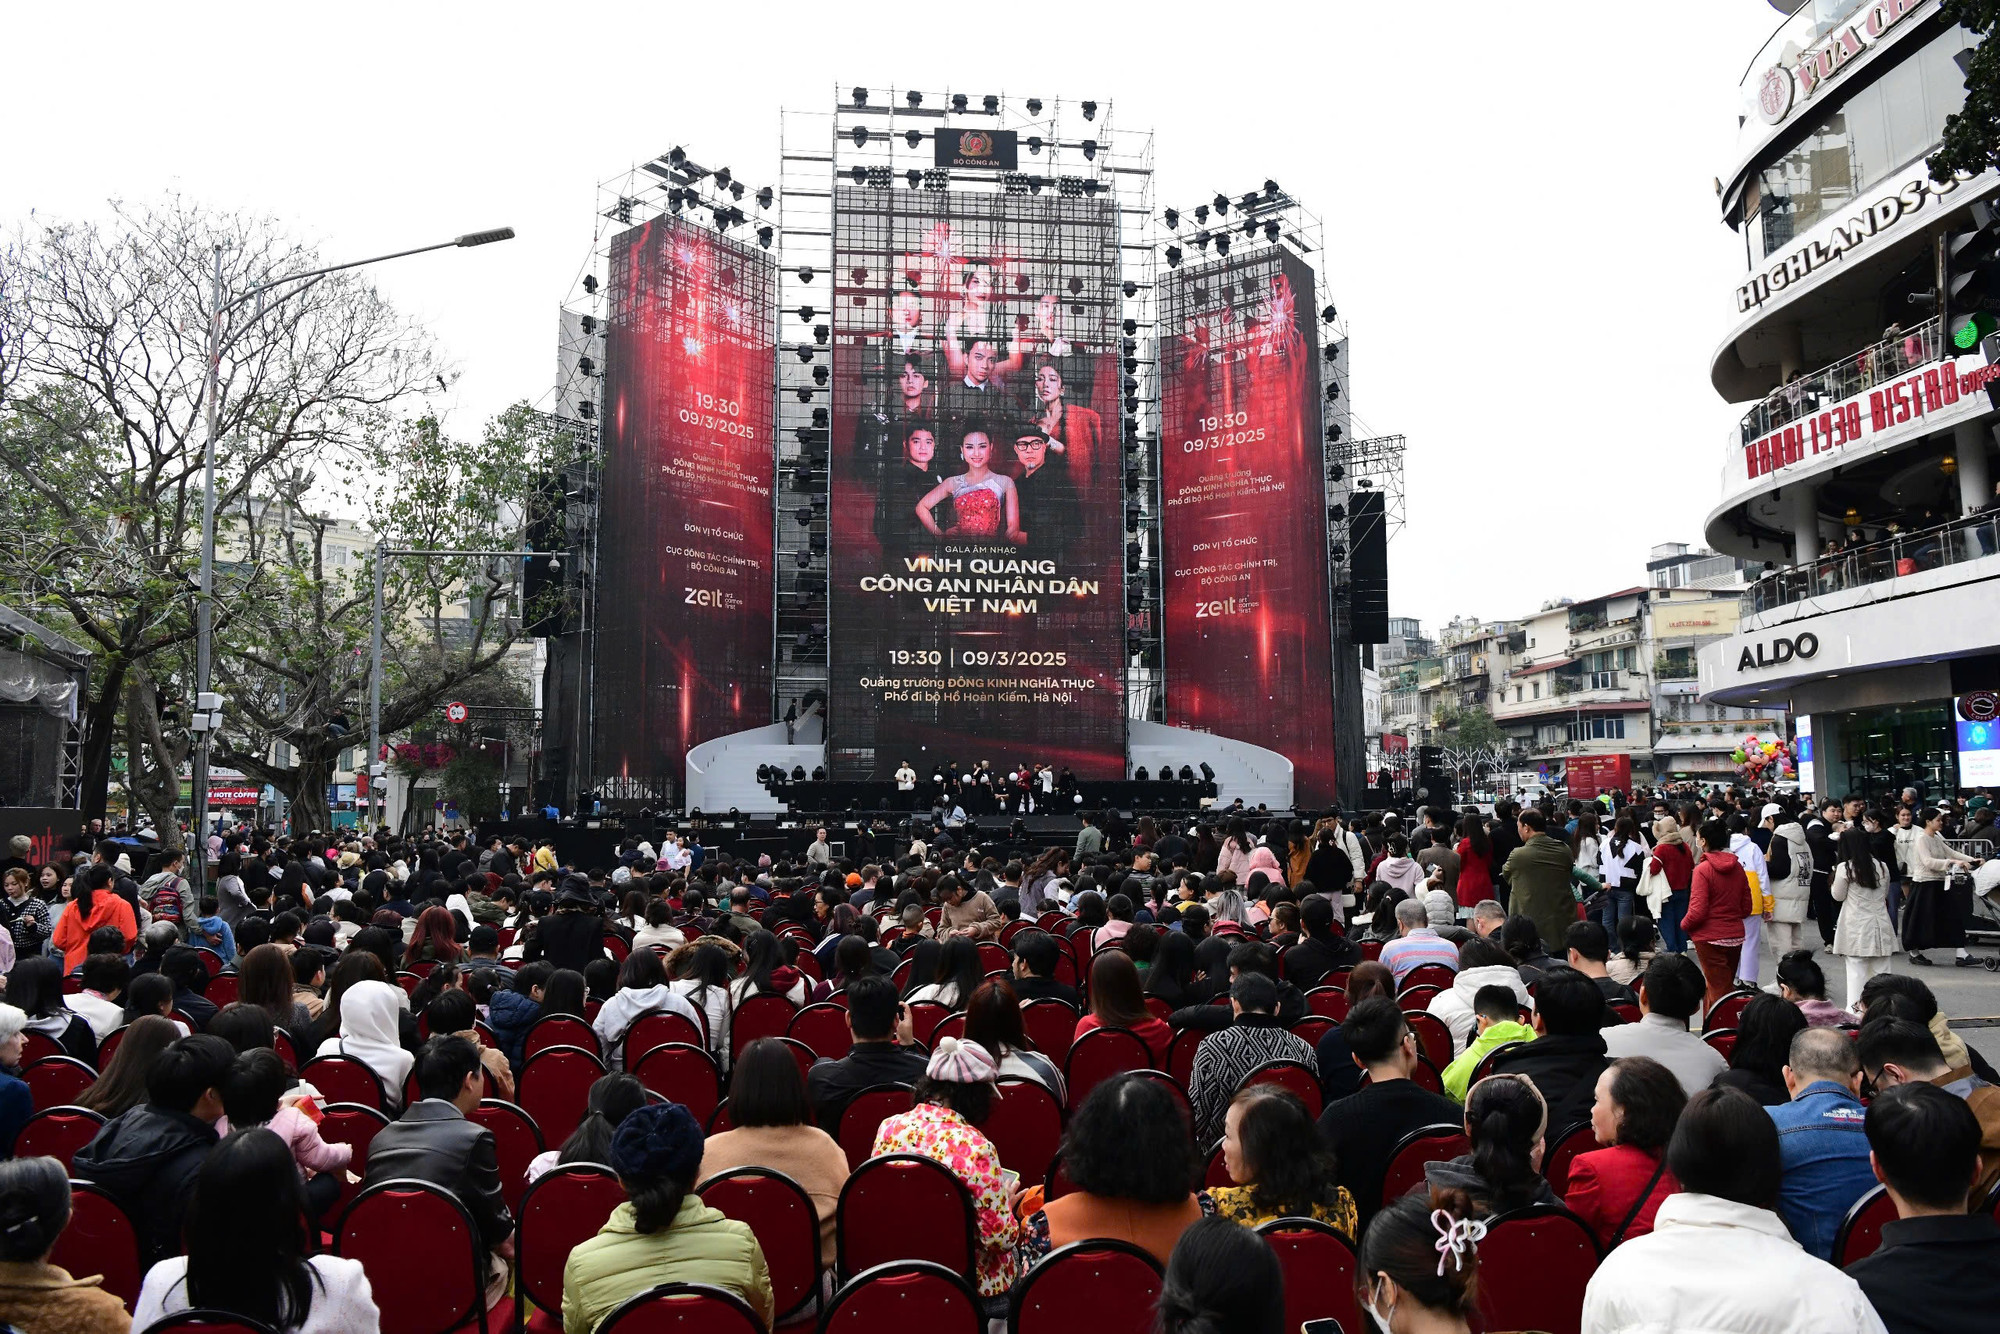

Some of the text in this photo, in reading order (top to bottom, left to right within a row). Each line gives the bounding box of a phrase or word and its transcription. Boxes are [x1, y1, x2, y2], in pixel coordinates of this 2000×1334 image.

[1797, 25, 1867, 95] VUA
[965, 158, 988, 166] CÔNG
[1736, 180, 1923, 313] HIGHLANDS
[695, 391, 740, 417] 19:30
[679, 408, 755, 440] 09/3/2025
[1198, 411, 1248, 433] 19:30
[1745, 423, 1805, 480] HANOI
[1809, 401, 1862, 455] 1930
[1869, 361, 1960, 433] BISTRO
[1183, 427, 1266, 453] 09/3/2025
[696, 463, 715, 474] KINH
[739, 473, 759, 484] THỤC
[1203, 483, 1223, 492] KINH
[1249, 474, 1273, 485] THỤC
[702, 526, 710, 536] VỊ
[665, 545, 683, 556] CỤC
[683, 548, 705, 559] CÔNG
[706, 551, 721, 562] TÁC
[945, 544, 1017, 556] GALA ÂM NHẠC
[690, 562, 702, 572] BỘ
[703, 563, 725, 574] CÔNG
[903, 557, 1056, 575] VINH QUANG
[1174, 568, 1192, 578] CỤC
[1193, 565, 1217, 575] CÔNG
[1217, 562, 1233, 572] TÁC
[1234, 559, 1261, 569] CHÍNH
[859, 573, 1099, 595] CÔNG AN NHÂN DÂN
[1200, 573, 1251, 585] BỘ CÔNG AN
[923, 594, 1037, 616] VIỆT NAM
[888, 650, 1067, 666] 19:30 09/3/2025
[1737, 632, 1820, 672] ALDO
[859, 675, 1096, 691] Quảng trường ĐÔNG KINH NGHĨA THỤC
[884, 690, 909, 701] Phố
[911, 691, 922, 702] đi
[925, 691, 941, 703] bộ
[943, 690, 961, 702] Hồ
[963, 692, 995, 702] Hoàn
[1033, 692, 1050, 702] Hà
[1052, 692, 1072, 705] Nội
